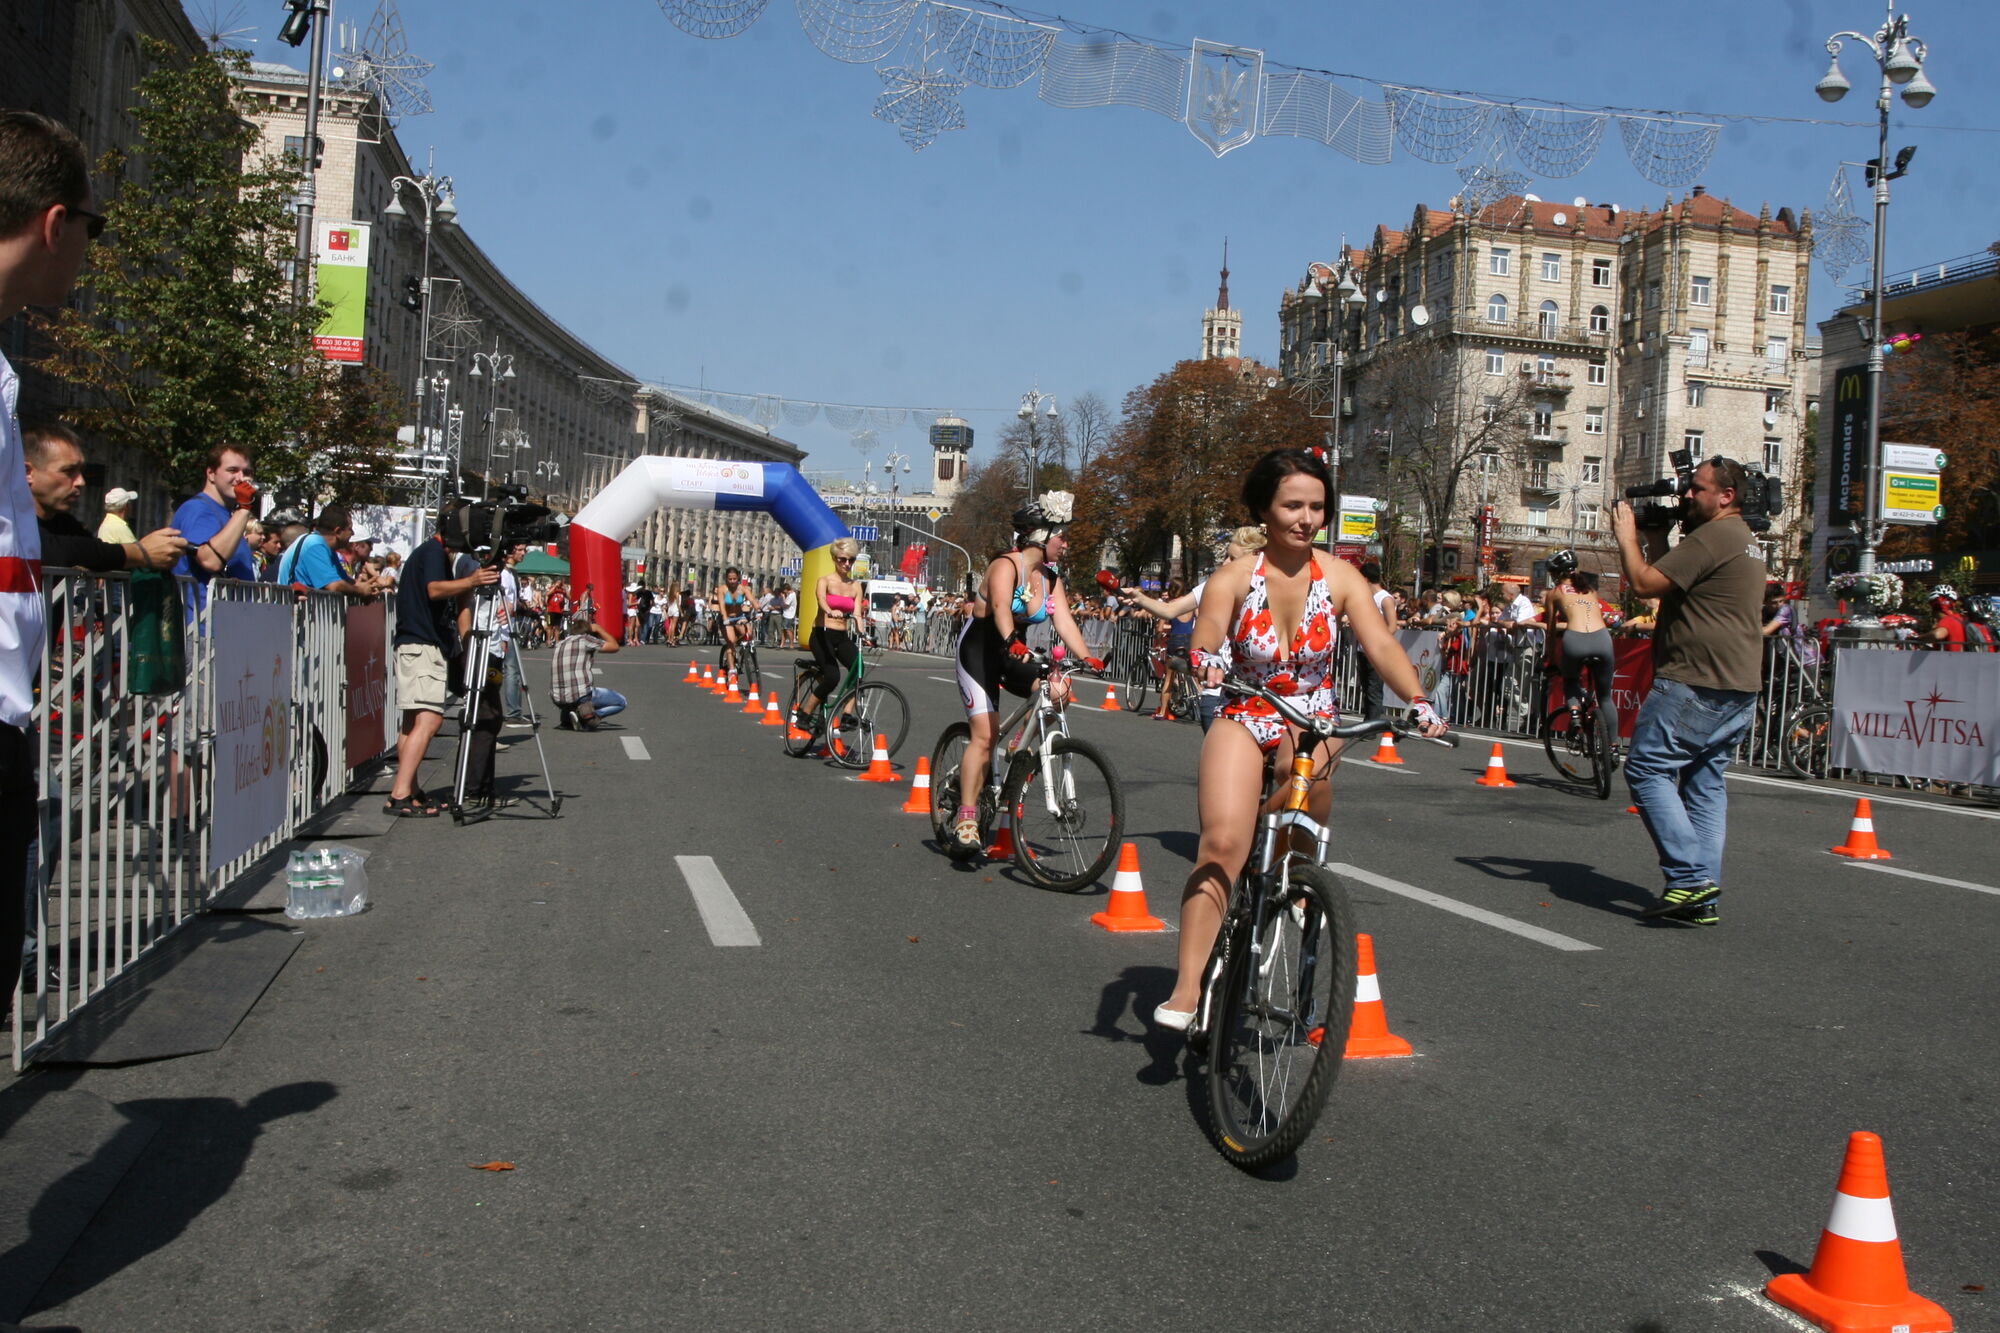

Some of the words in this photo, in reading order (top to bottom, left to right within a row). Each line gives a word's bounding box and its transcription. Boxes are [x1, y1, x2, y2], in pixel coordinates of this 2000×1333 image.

[330, 234, 358, 244] БТА
[331, 253, 355, 262] БАНК
[1840, 413, 1853, 510] McDonald's
[220, 680, 262, 737] MILAVITSA
[1850, 700, 1985, 749] MILAVITSA
